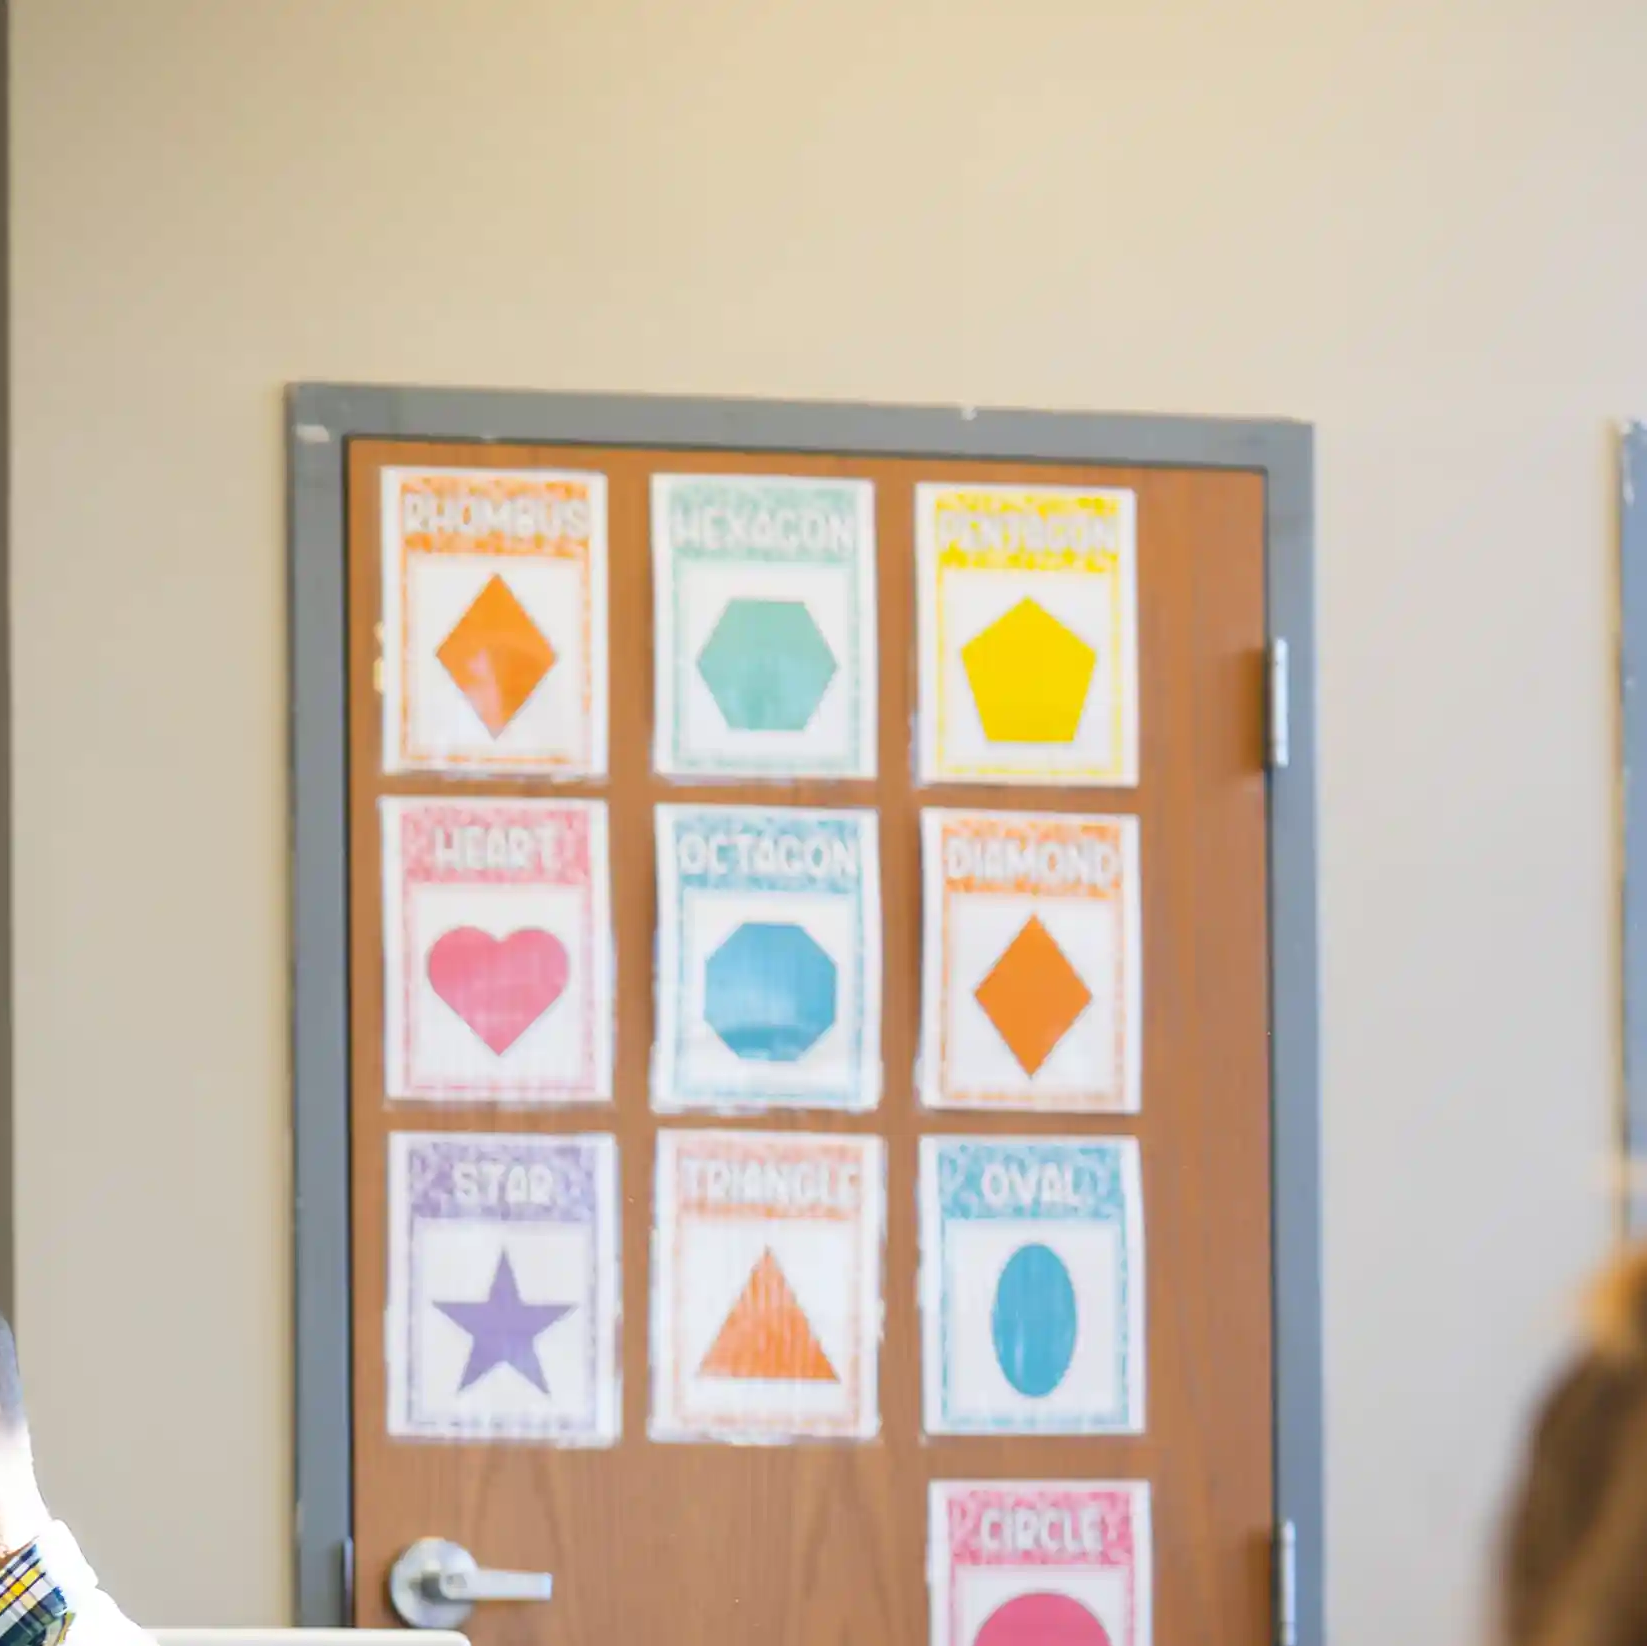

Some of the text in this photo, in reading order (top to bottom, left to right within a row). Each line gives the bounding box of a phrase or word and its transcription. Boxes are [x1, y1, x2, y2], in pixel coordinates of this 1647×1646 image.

[402, 492, 592, 537] RHOMBUS
[671, 506, 855, 554] HEXAGON
[939, 511, 1119, 552] PENTAGON
[434, 825, 557, 872] HEART
[679, 834, 858, 880] OCTAGON
[947, 836, 1122, 888] DIAMOND
[456, 1161, 554, 1205] STAR
[681, 1159, 861, 1205] TRIANGLE
[982, 1162, 1084, 1208] OVAL
[982, 1508, 1104, 1557] CIRCLE
